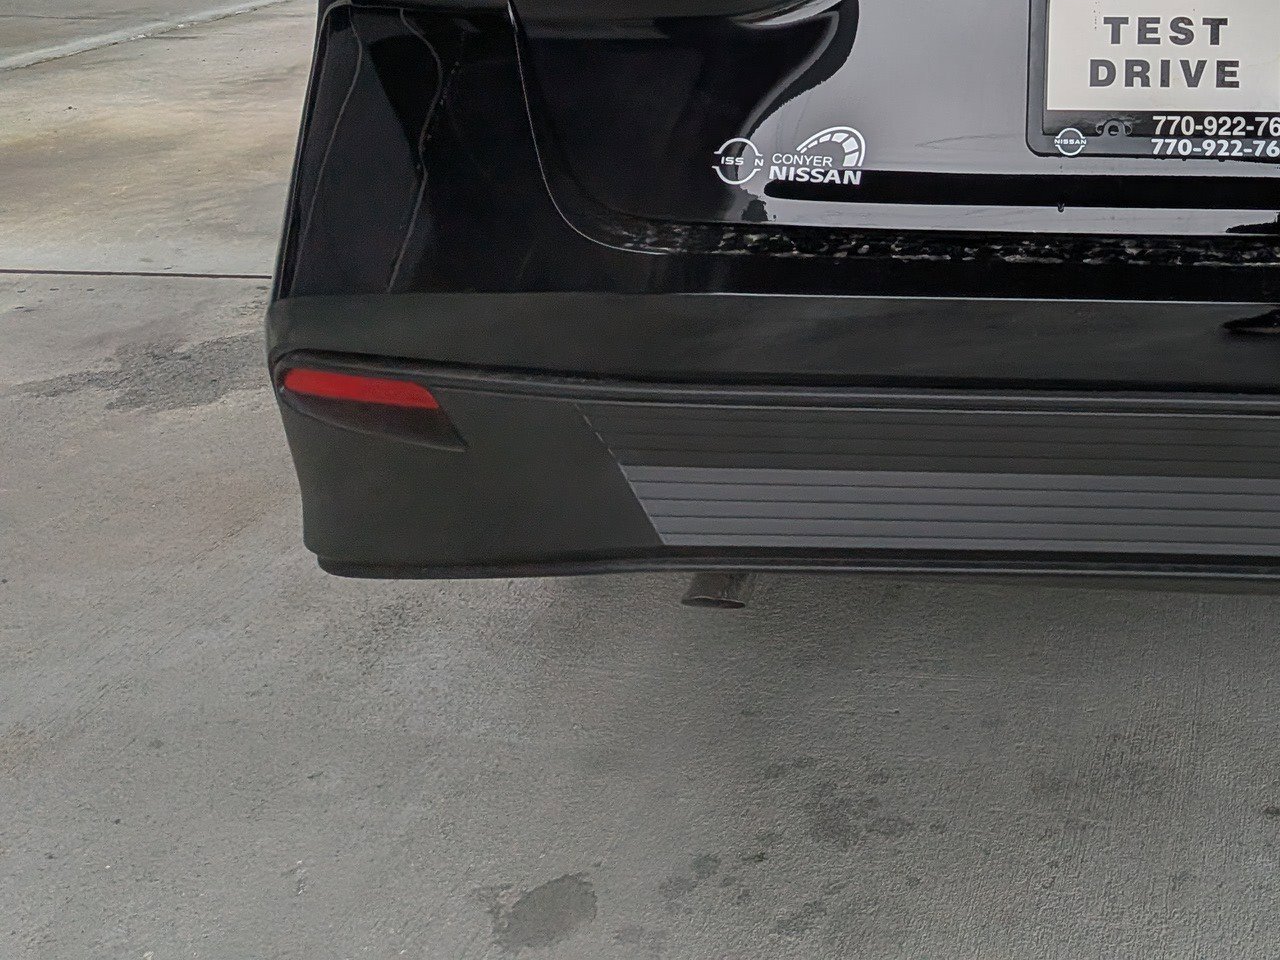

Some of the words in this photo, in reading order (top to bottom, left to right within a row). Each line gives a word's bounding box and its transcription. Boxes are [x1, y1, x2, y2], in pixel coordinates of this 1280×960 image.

[1103, 16, 1229, 46] TEST
[1089, 59, 1240, 88] DRIVE
[768, 165, 862, 186] NISSAN
